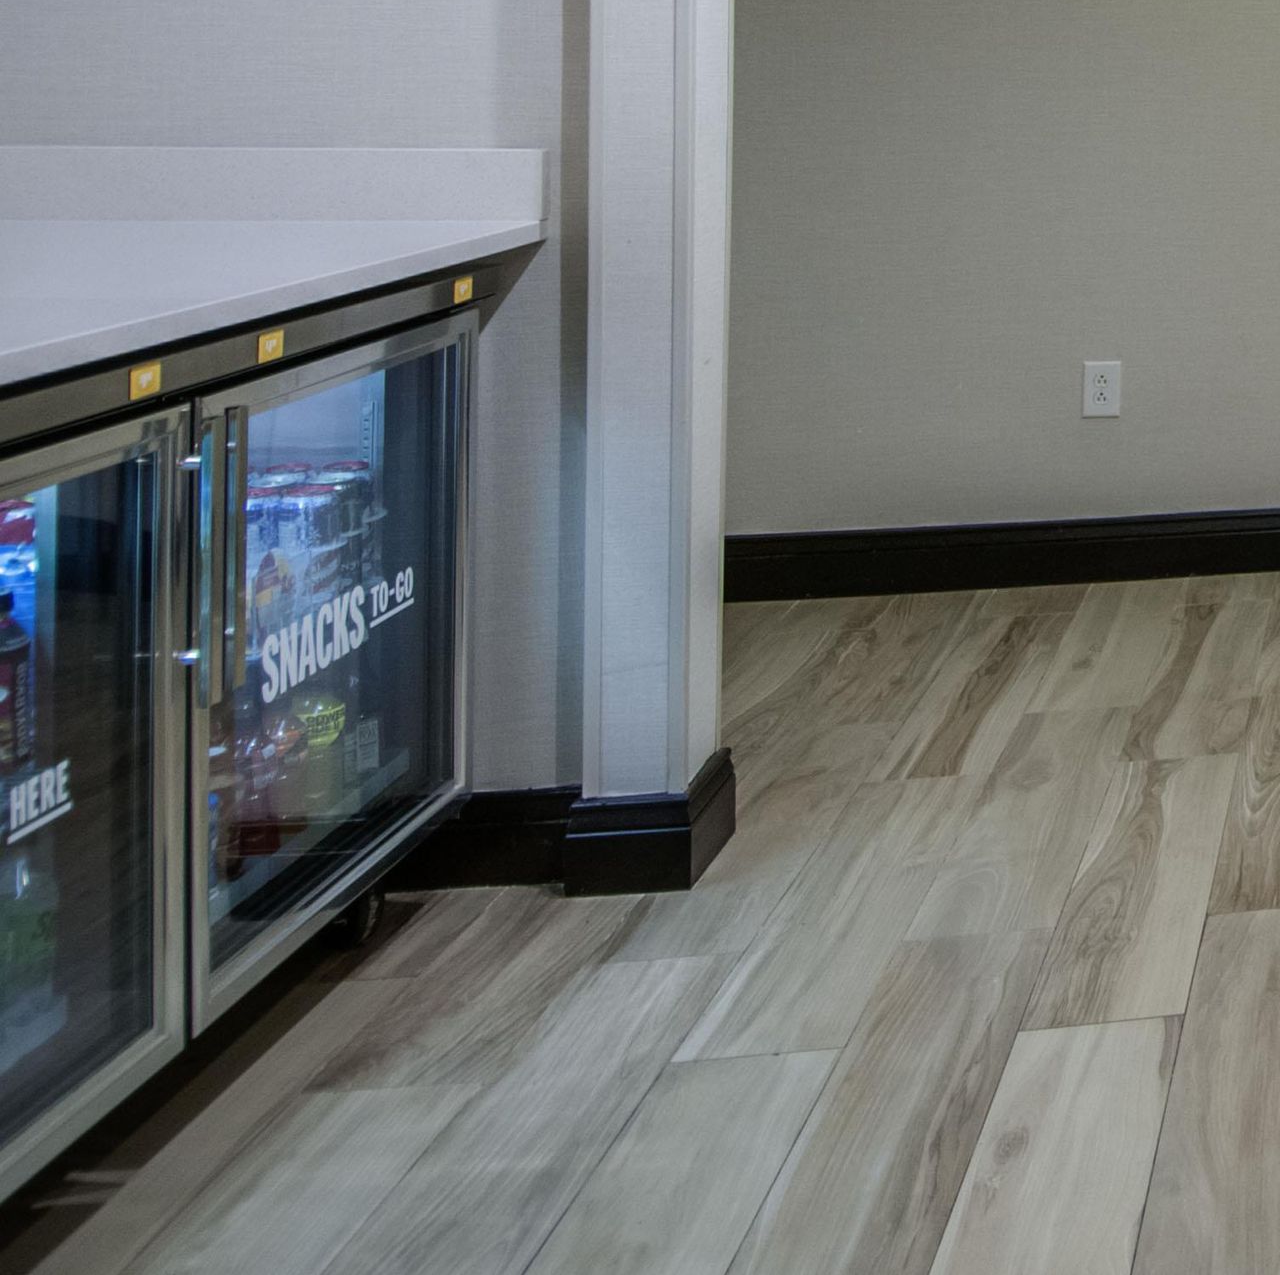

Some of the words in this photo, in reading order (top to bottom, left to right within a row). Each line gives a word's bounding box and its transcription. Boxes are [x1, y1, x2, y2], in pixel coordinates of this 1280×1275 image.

[369, 565, 415, 618] TO-GO
[261, 584, 366, 705] SNACKS
[10, 758, 71, 832] HERE
